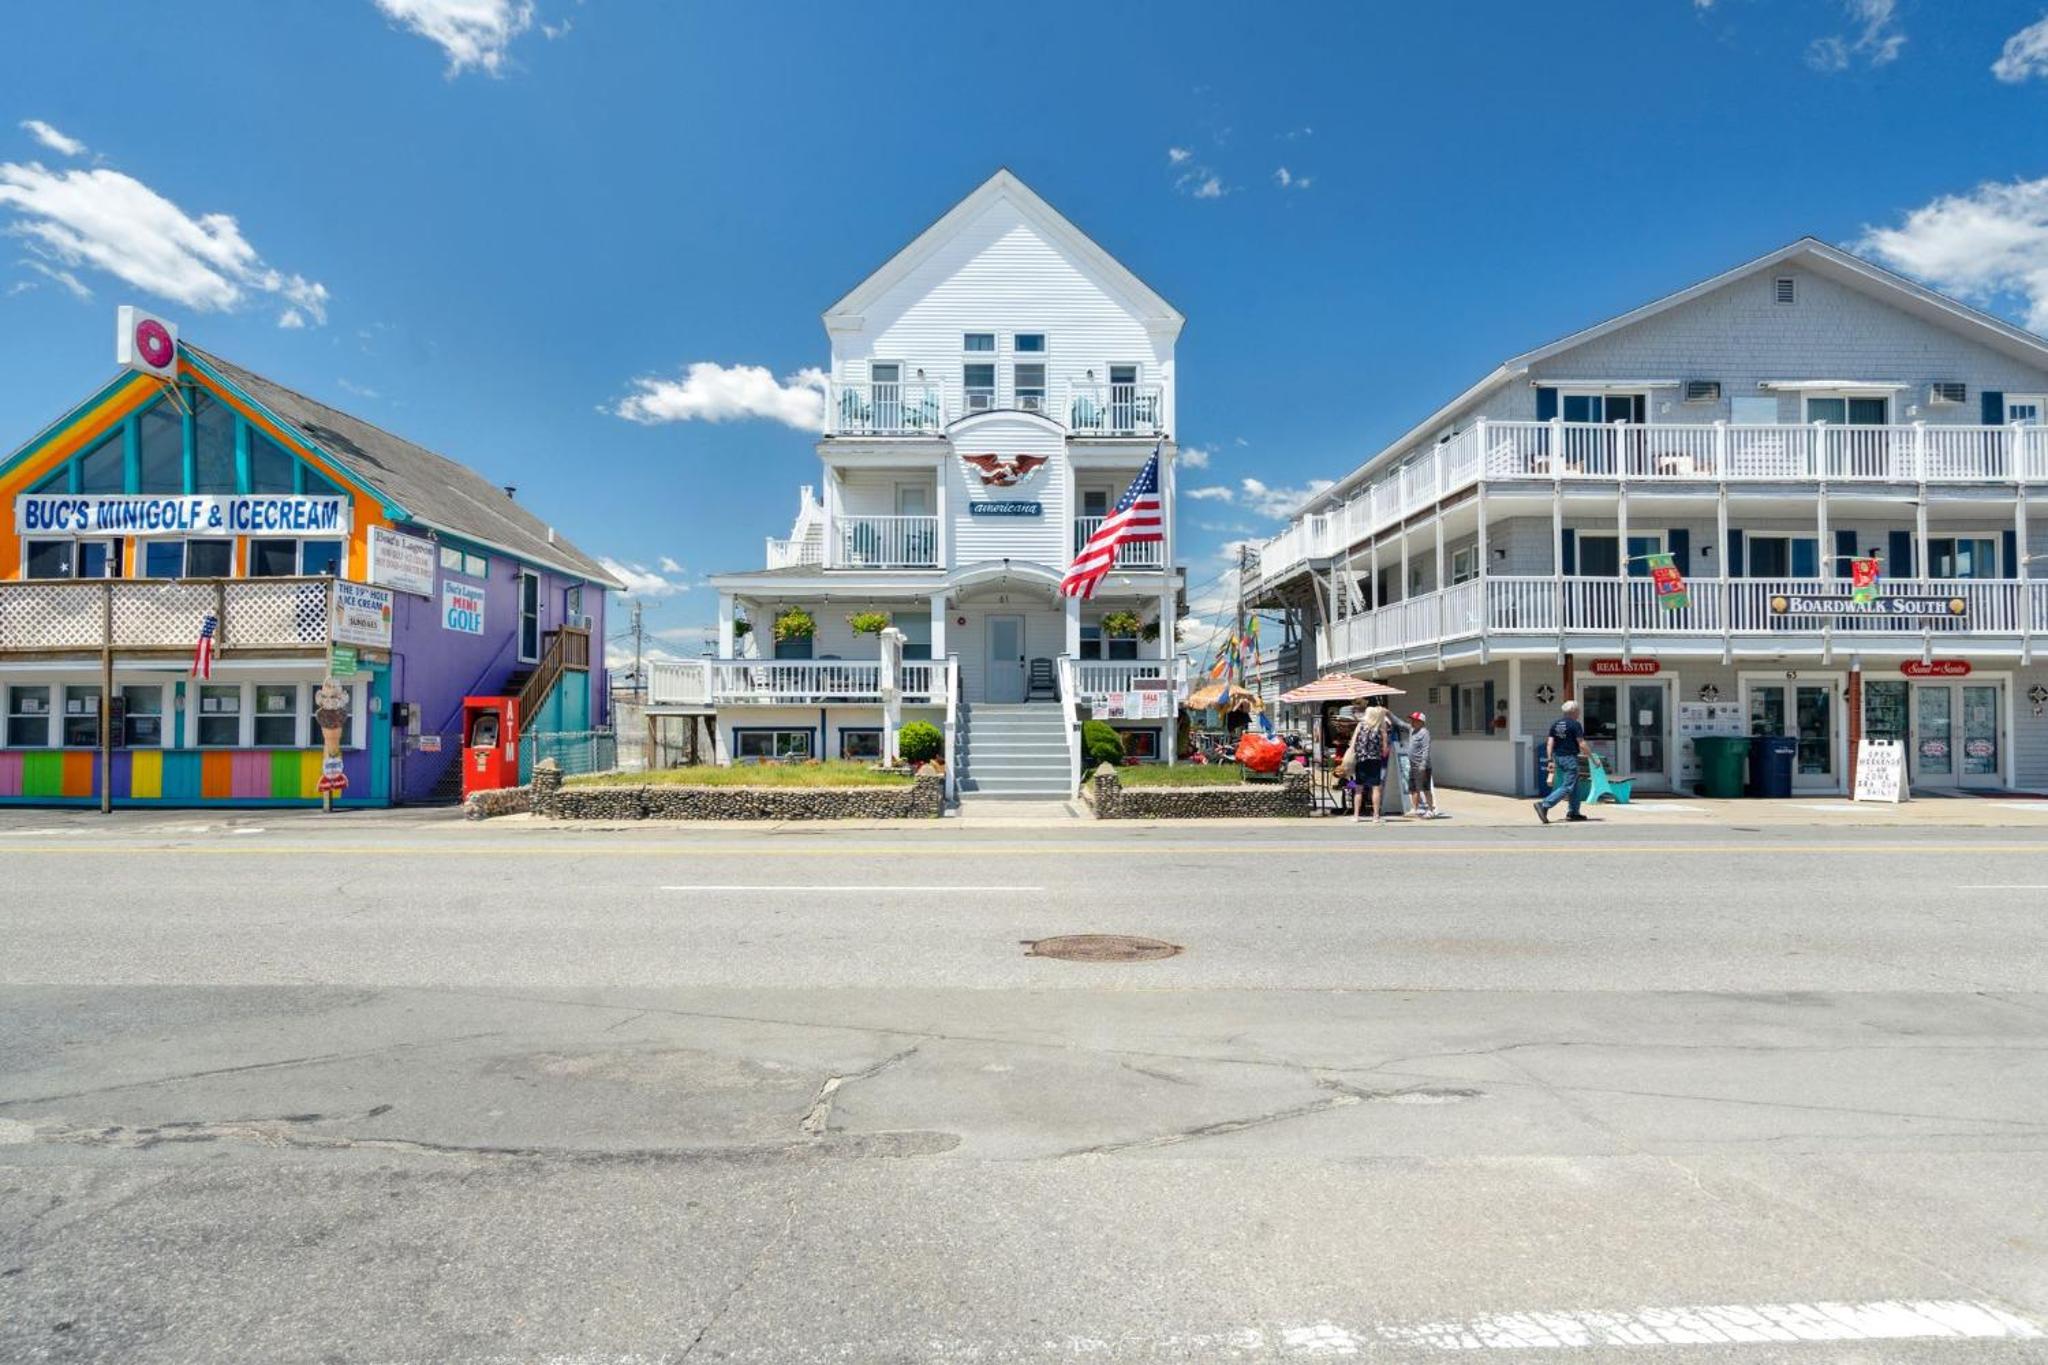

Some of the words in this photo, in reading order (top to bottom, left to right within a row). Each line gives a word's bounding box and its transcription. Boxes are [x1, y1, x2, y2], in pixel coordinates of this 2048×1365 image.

[26, 500, 90, 529] BUC'S
[97, 500, 203, 529] MINIGOLF
[208, 504, 223, 528] &
[229, 500, 339, 529] ICECREAM
[338, 583, 353, 596] THE
[371, 590, 389, 603] HOLE
[344, 595, 356, 607] ICE
[357, 598, 383, 612] CREAM
[452, 596, 477, 613] MINI
[448, 608, 481, 633] GOLF
[1597, 662, 1620, 672] REAL
[506, 700, 515, 762] ATM
